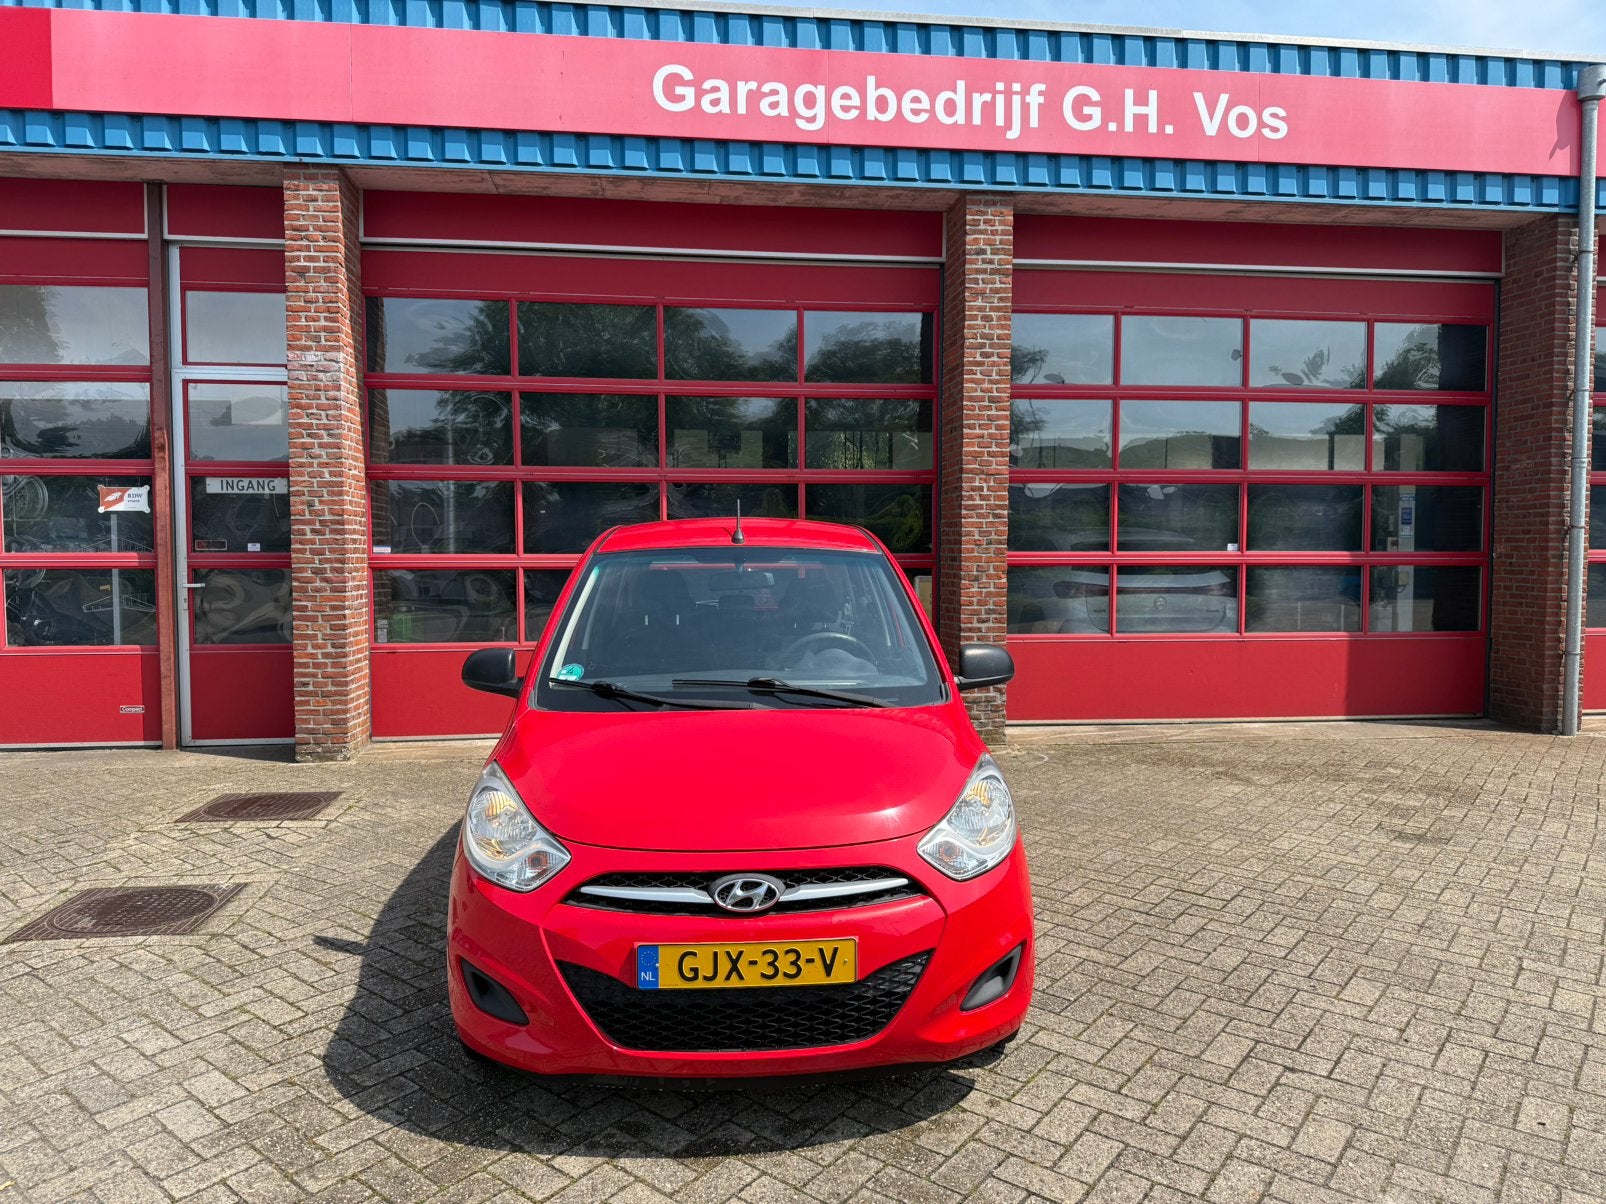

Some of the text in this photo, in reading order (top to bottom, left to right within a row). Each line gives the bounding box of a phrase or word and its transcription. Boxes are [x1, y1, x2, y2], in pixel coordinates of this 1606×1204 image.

[651, 63, 1289, 141] Garagebedrijf G.H. Vos
[220, 479, 276, 492] INGANG
[641, 971, 656, 981] NL
[677, 946, 839, 982] GJX-33-V
